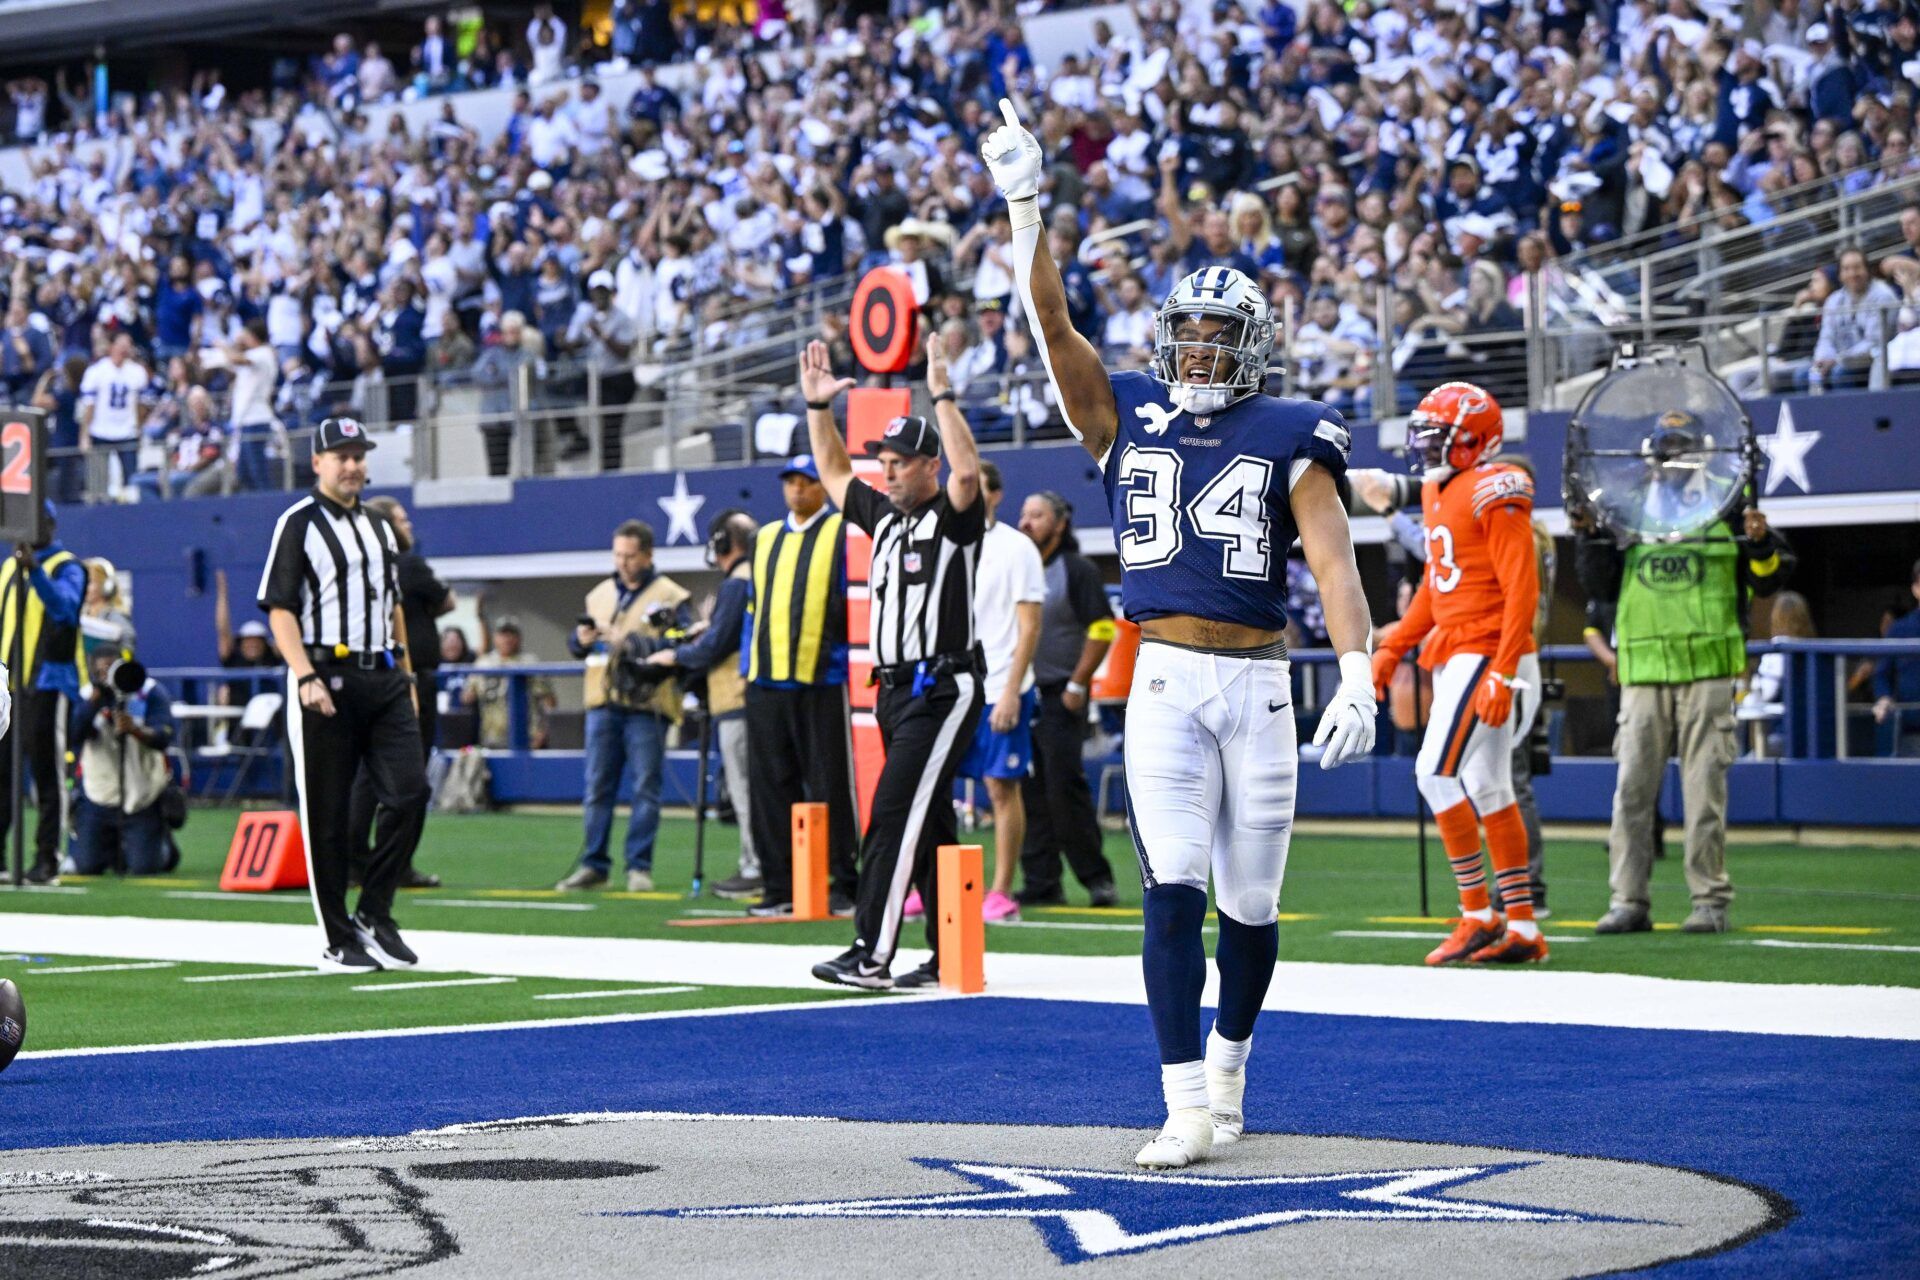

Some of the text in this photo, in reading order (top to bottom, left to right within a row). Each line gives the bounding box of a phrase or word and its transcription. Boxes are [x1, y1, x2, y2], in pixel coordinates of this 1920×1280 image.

[0, 422, 32, 494] 2
[1179, 437, 1222, 447] COWBOYS
[1119, 441, 1273, 582] 34
[1650, 556, 1690, 576] FOX
[233, 822, 279, 878] 10
